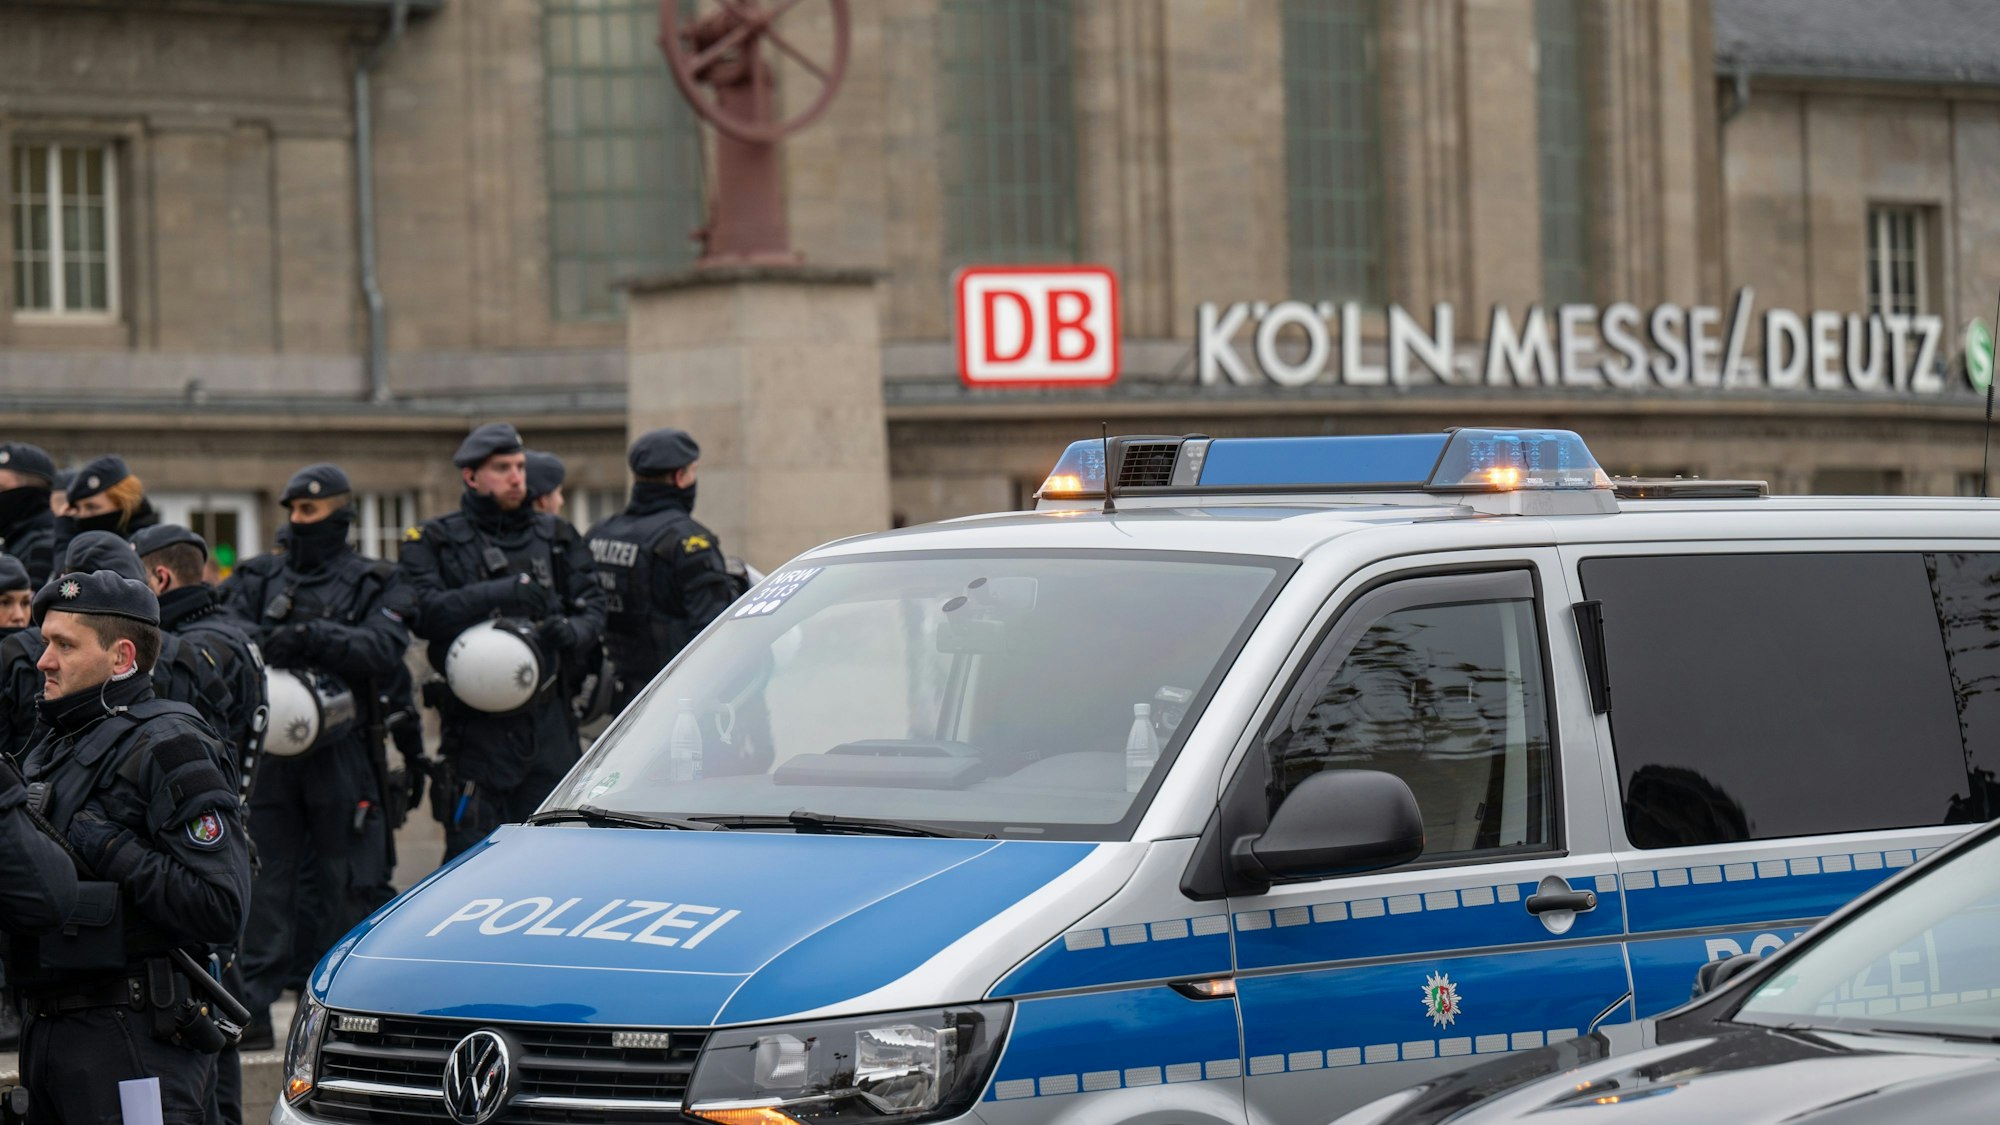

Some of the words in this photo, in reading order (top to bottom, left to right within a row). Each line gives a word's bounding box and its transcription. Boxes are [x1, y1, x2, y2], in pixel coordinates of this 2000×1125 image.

[981, 289, 1097, 365] DB
[1199, 300, 1455, 386] KÖLN
[752, 583, 799, 601] 3113
[768, 567, 822, 586] NRW
[425, 897, 742, 949] POLIZEI
